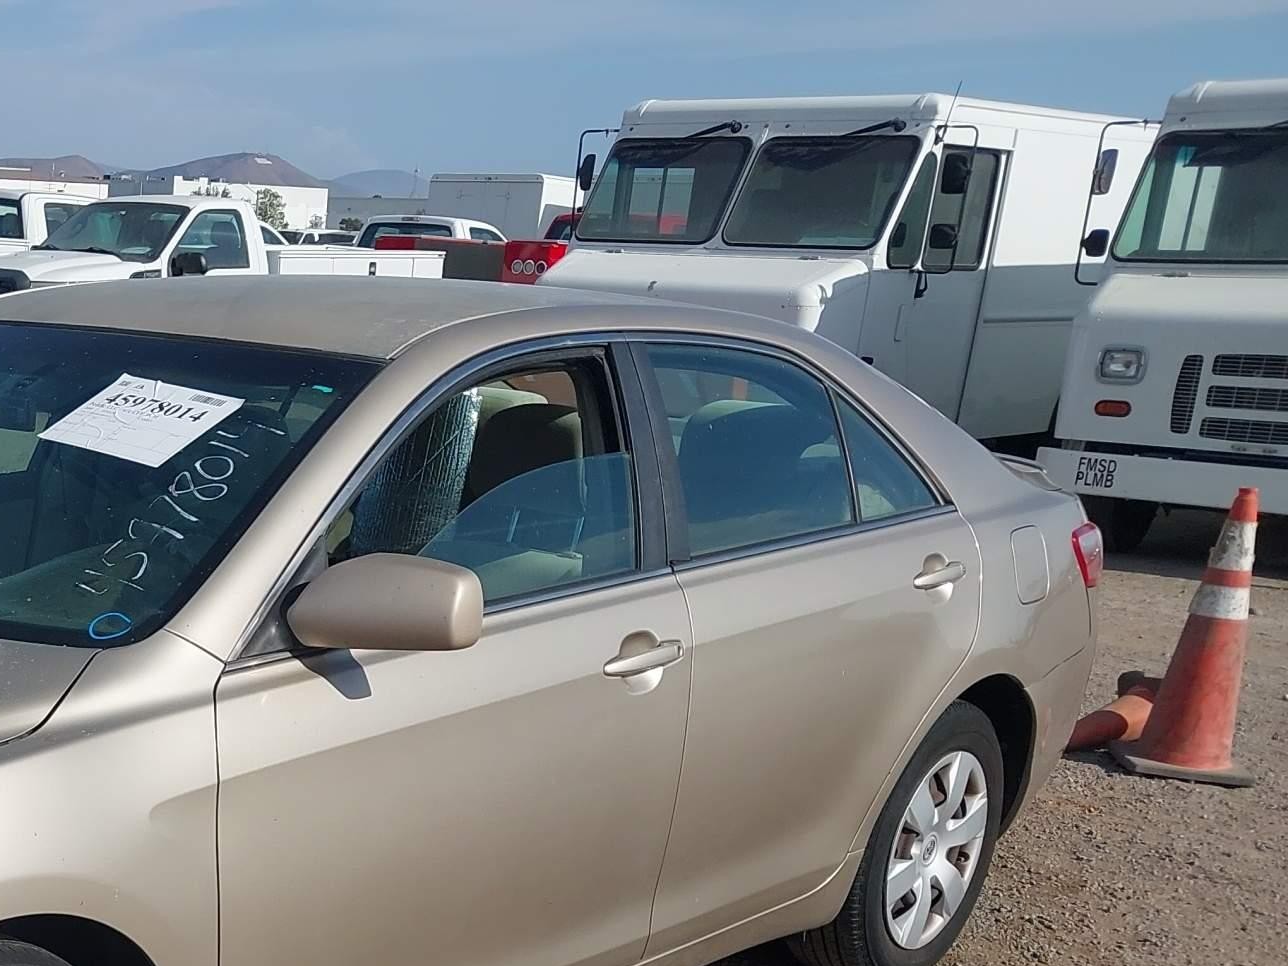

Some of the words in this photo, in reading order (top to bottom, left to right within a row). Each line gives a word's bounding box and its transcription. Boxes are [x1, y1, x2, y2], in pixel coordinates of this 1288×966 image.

[105, 393, 209, 423] 45978014
[1077, 456, 1117, 474] FMSD
[1074, 470, 1114, 488] PLMB
